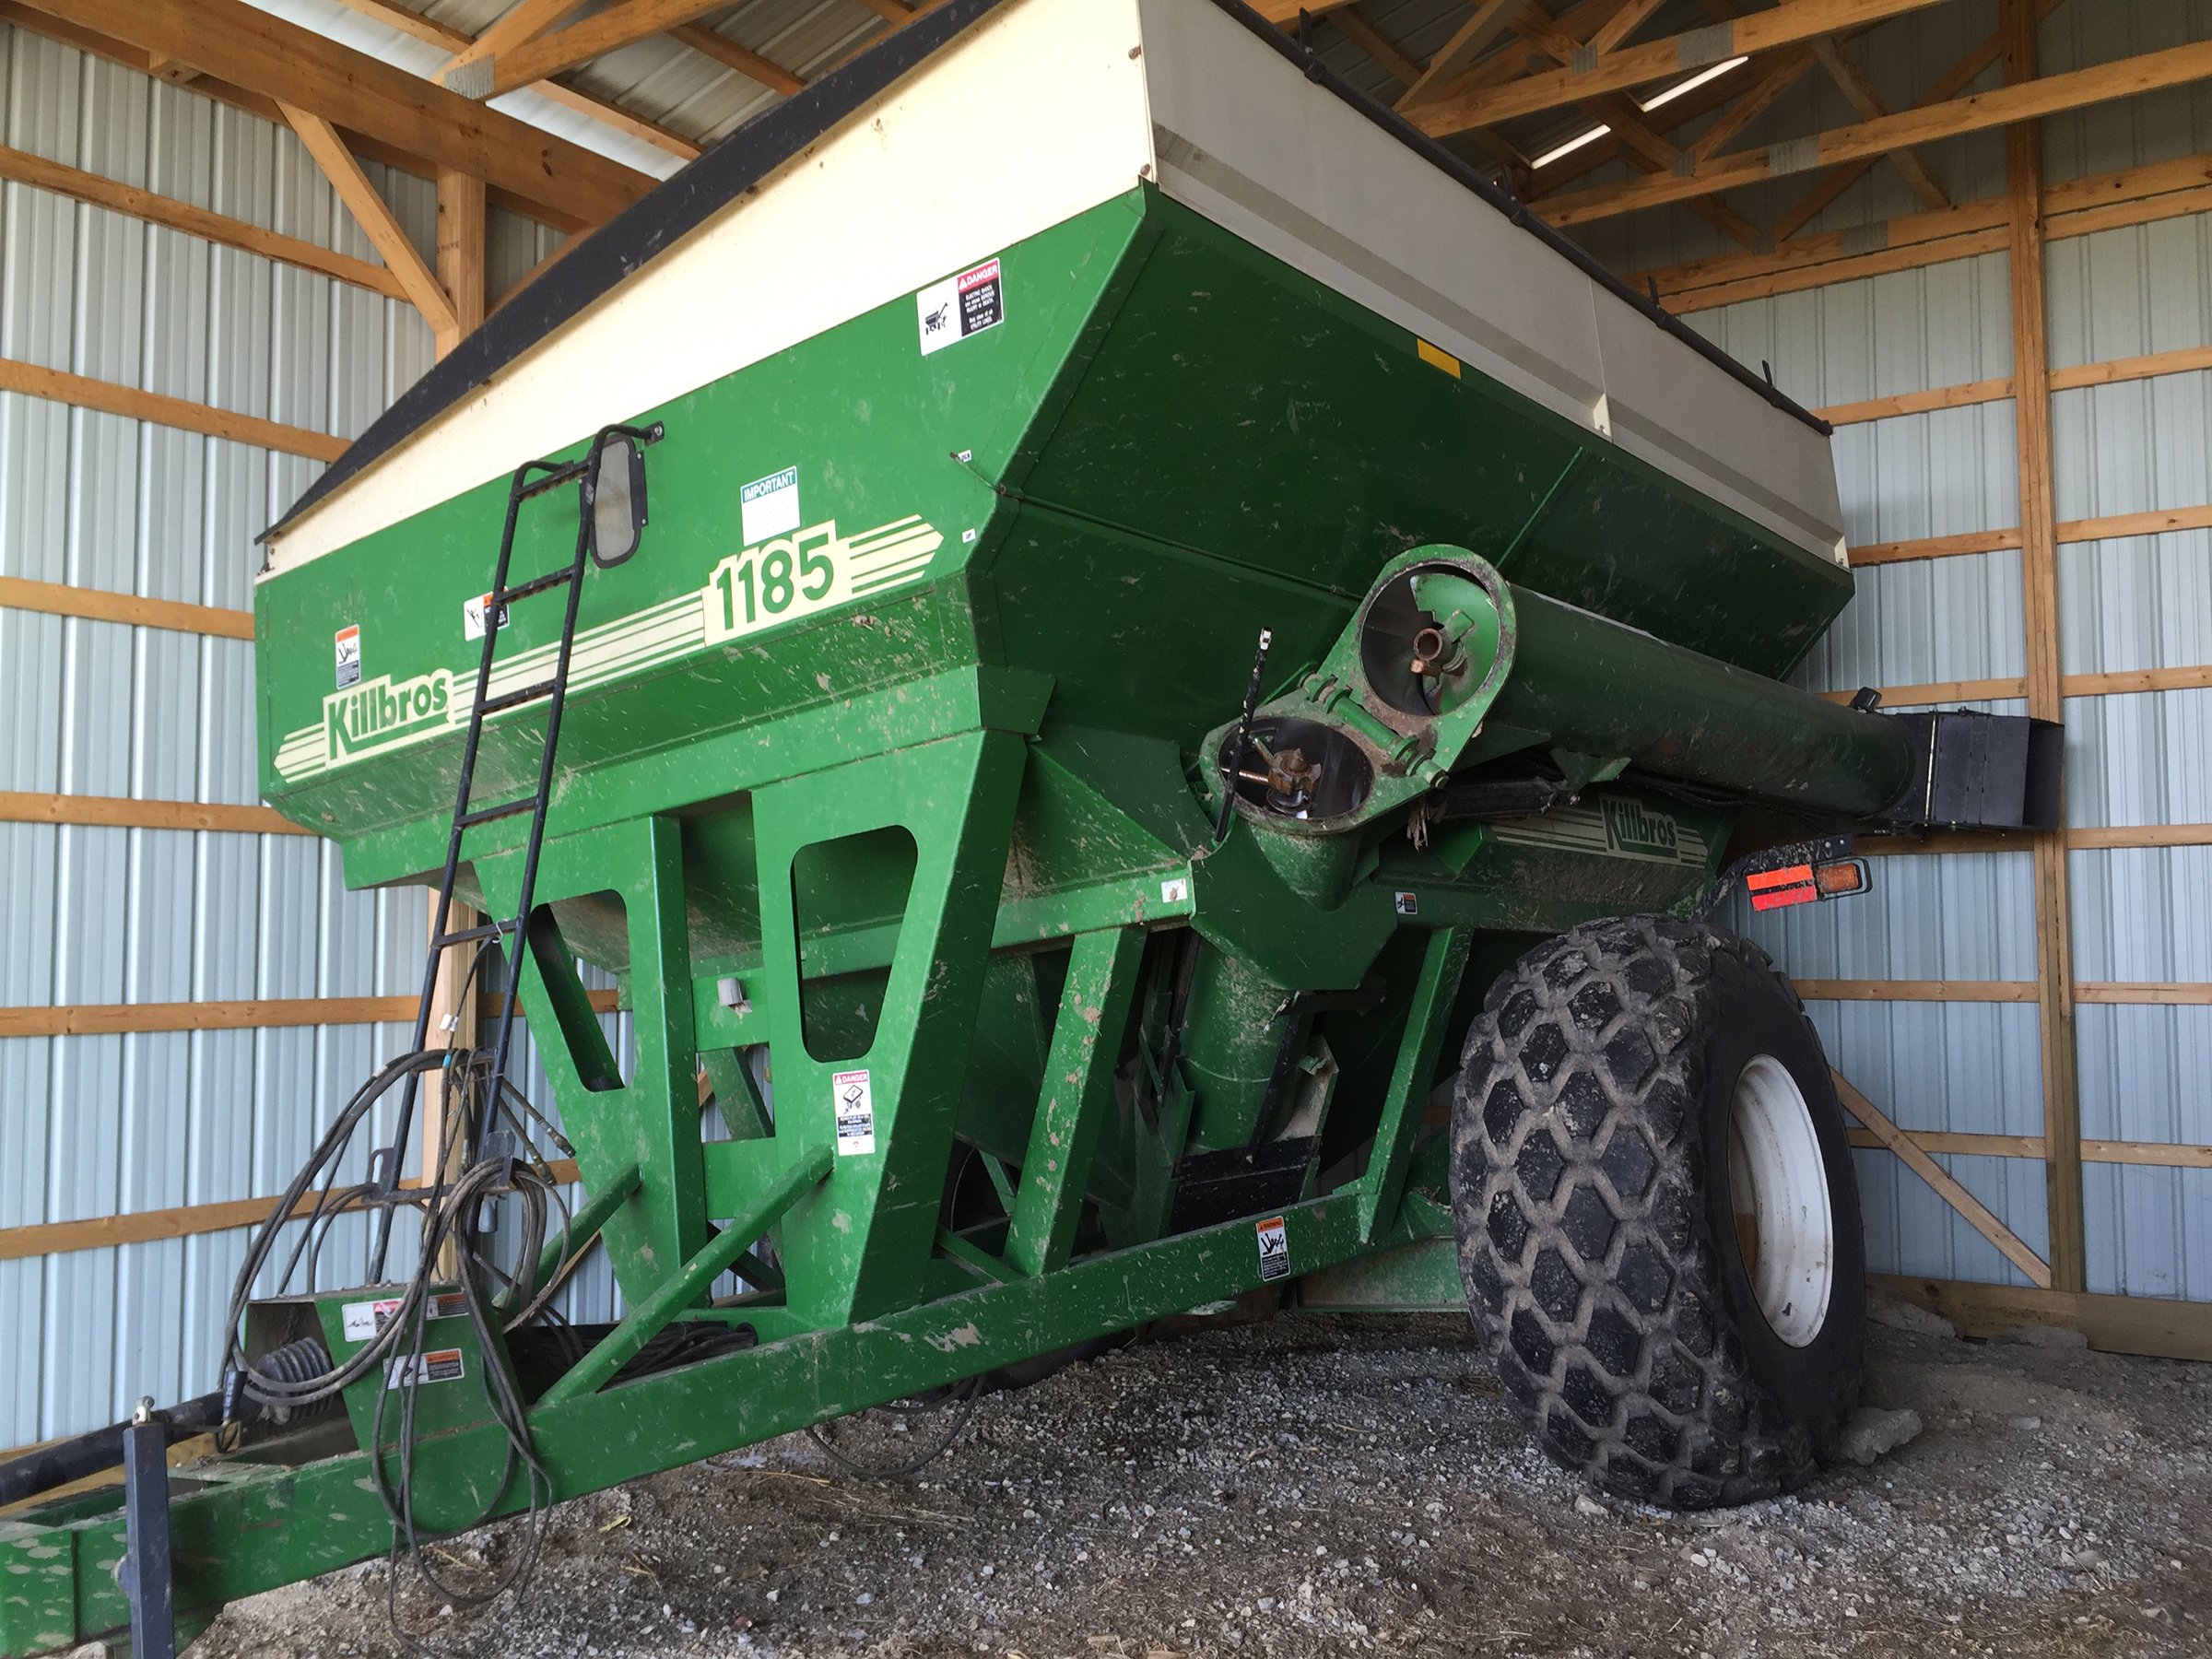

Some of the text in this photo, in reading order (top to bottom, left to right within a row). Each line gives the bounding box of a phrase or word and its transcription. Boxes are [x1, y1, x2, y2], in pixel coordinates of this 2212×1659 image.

[966, 265, 998, 286] DANGER
[744, 471, 794, 502] IMPORTANT
[716, 533, 834, 630] 1185
[327, 676, 449, 760] Killbros
[1603, 798, 1677, 850] Killbros
[841, 1073, 868, 1083] DANGER
